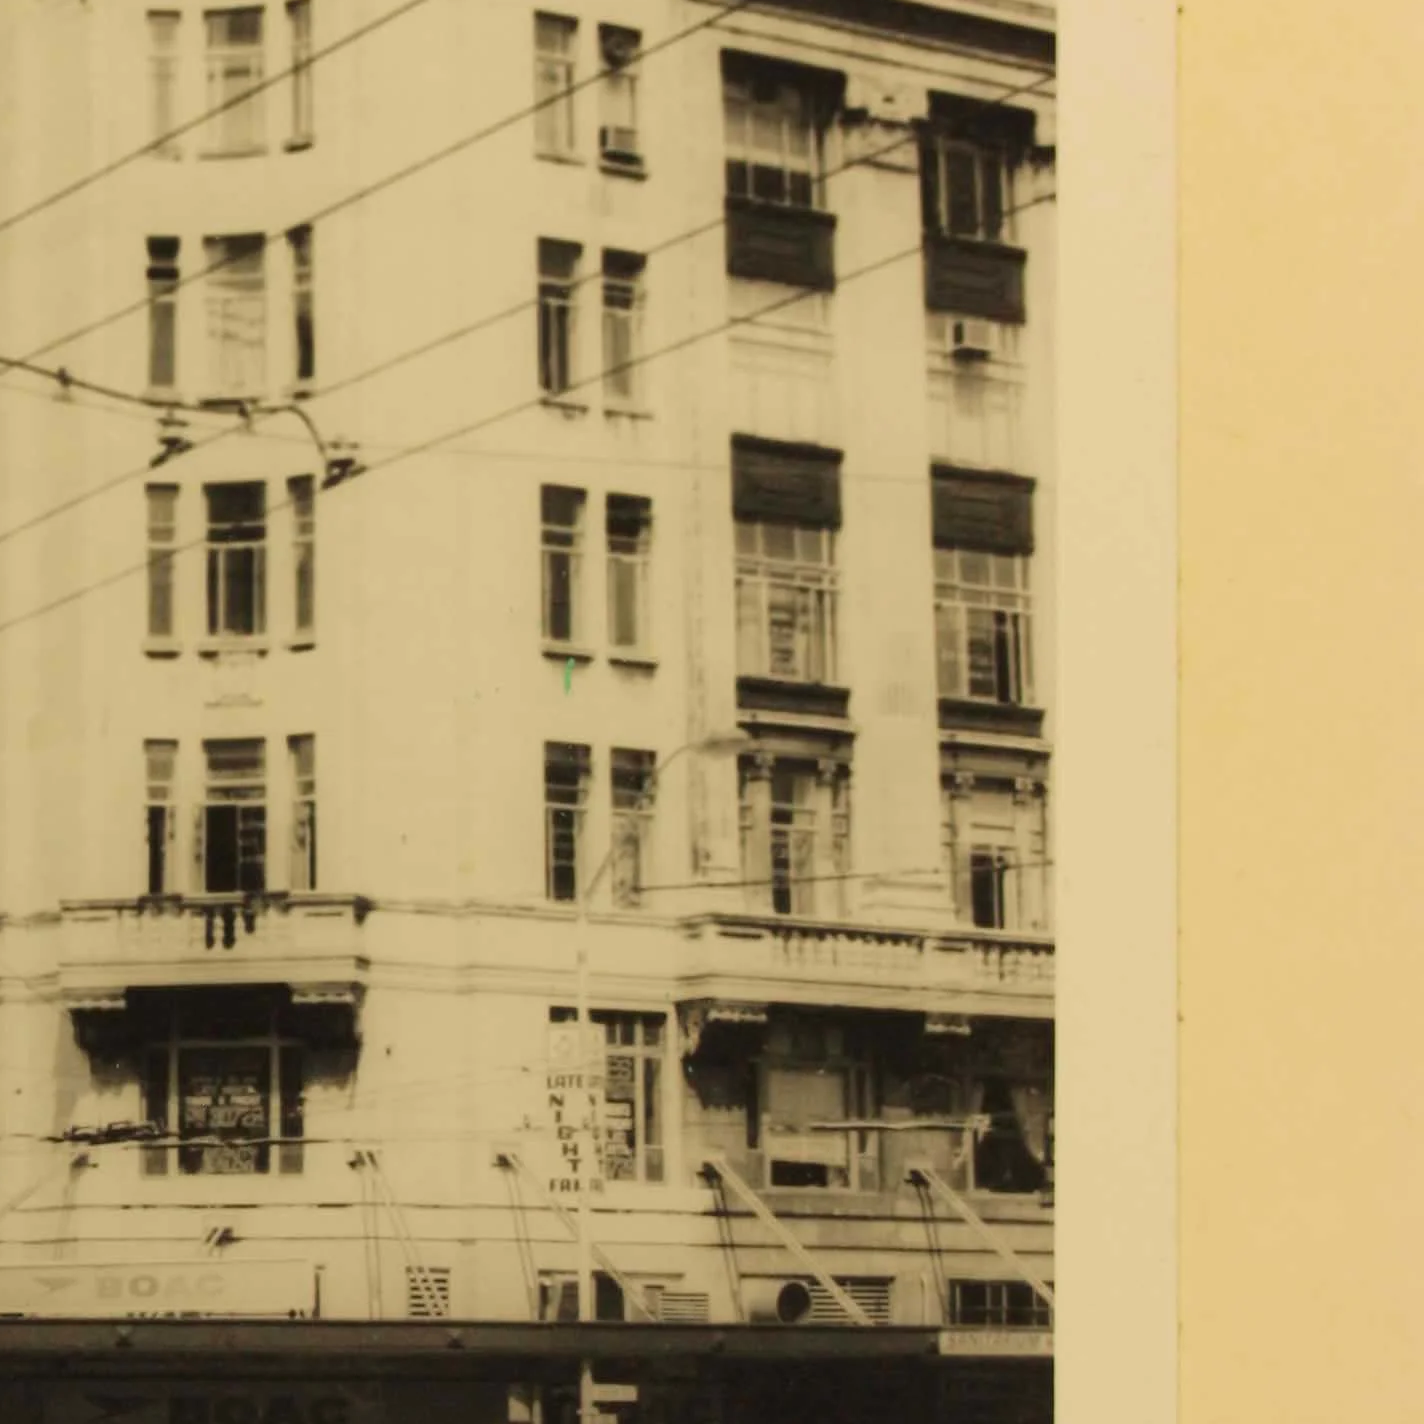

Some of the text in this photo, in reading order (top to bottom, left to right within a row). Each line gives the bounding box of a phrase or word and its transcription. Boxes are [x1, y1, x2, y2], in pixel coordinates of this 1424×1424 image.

[546, 1074, 583, 1090] LATE
[548, 1093, 582, 1173] NIGHT
[95, 1271, 226, 1299] BOAC
